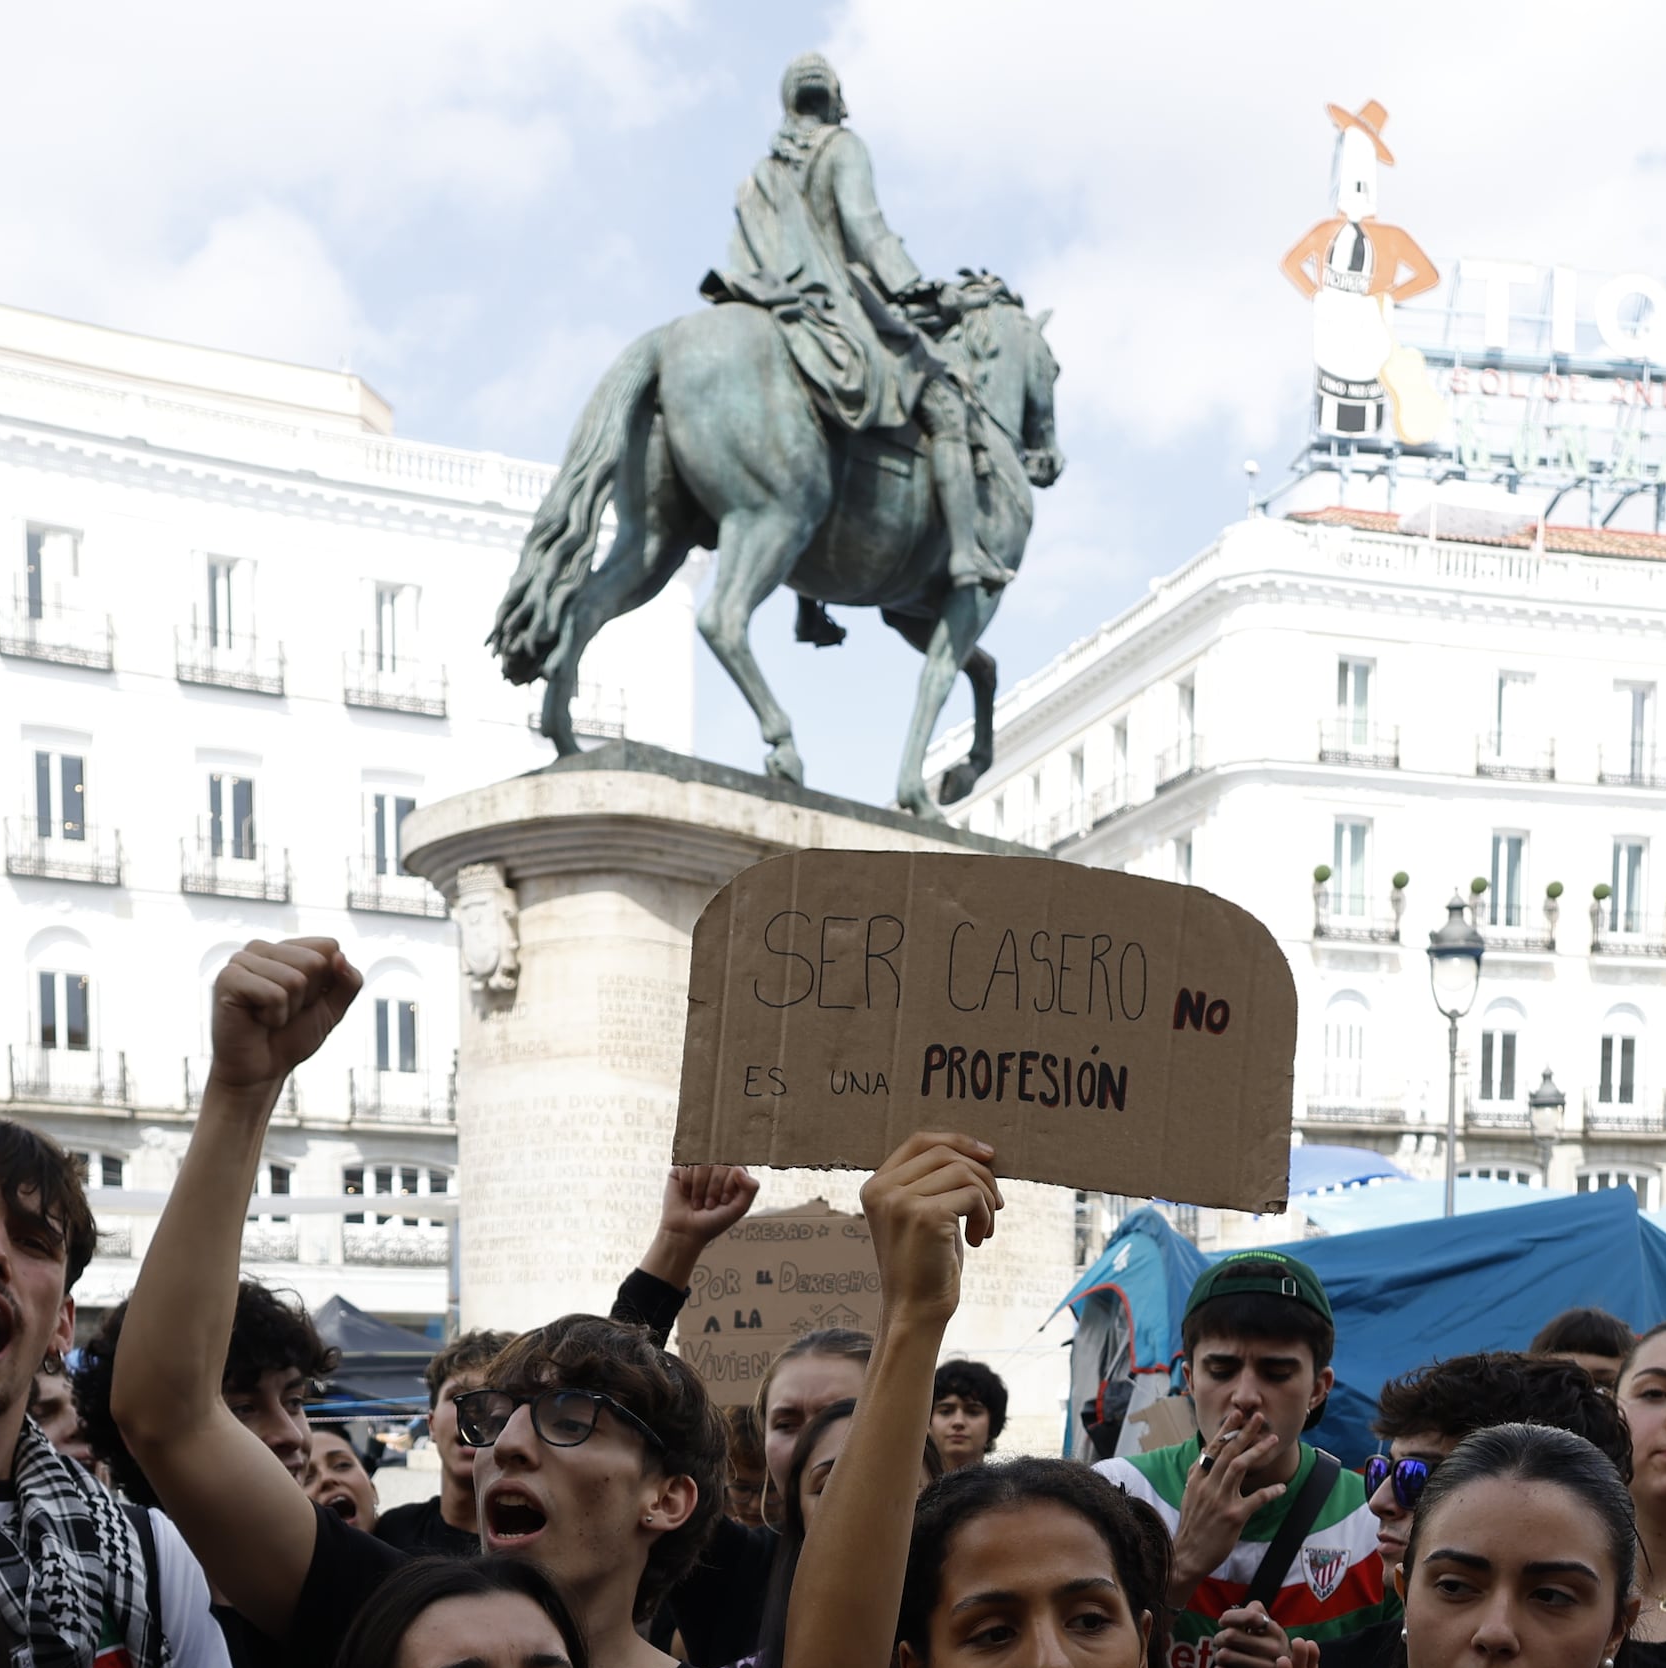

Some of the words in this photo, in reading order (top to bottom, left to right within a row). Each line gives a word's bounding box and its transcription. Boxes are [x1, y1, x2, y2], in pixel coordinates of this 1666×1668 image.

[1452, 366, 1530, 399] SOL
[1543, 373, 1588, 401] DE
[754, 910, 904, 1010] SER
[948, 921, 1147, 1022] CASERO
[1173, 986, 1231, 1035] NO
[744, 1065, 787, 1097] ES
[831, 1068, 890, 1095] UNA
[921, 1044, 1129, 1112] PROFESIÓN
[745, 1223, 813, 1241] RESAD
[688, 1265, 740, 1307] POR
[756, 1270, 773, 1285] EL
[779, 1262, 880, 1294] DERECHO
[704, 1316, 721, 1333] A
[734, 1309, 763, 1329] LA
